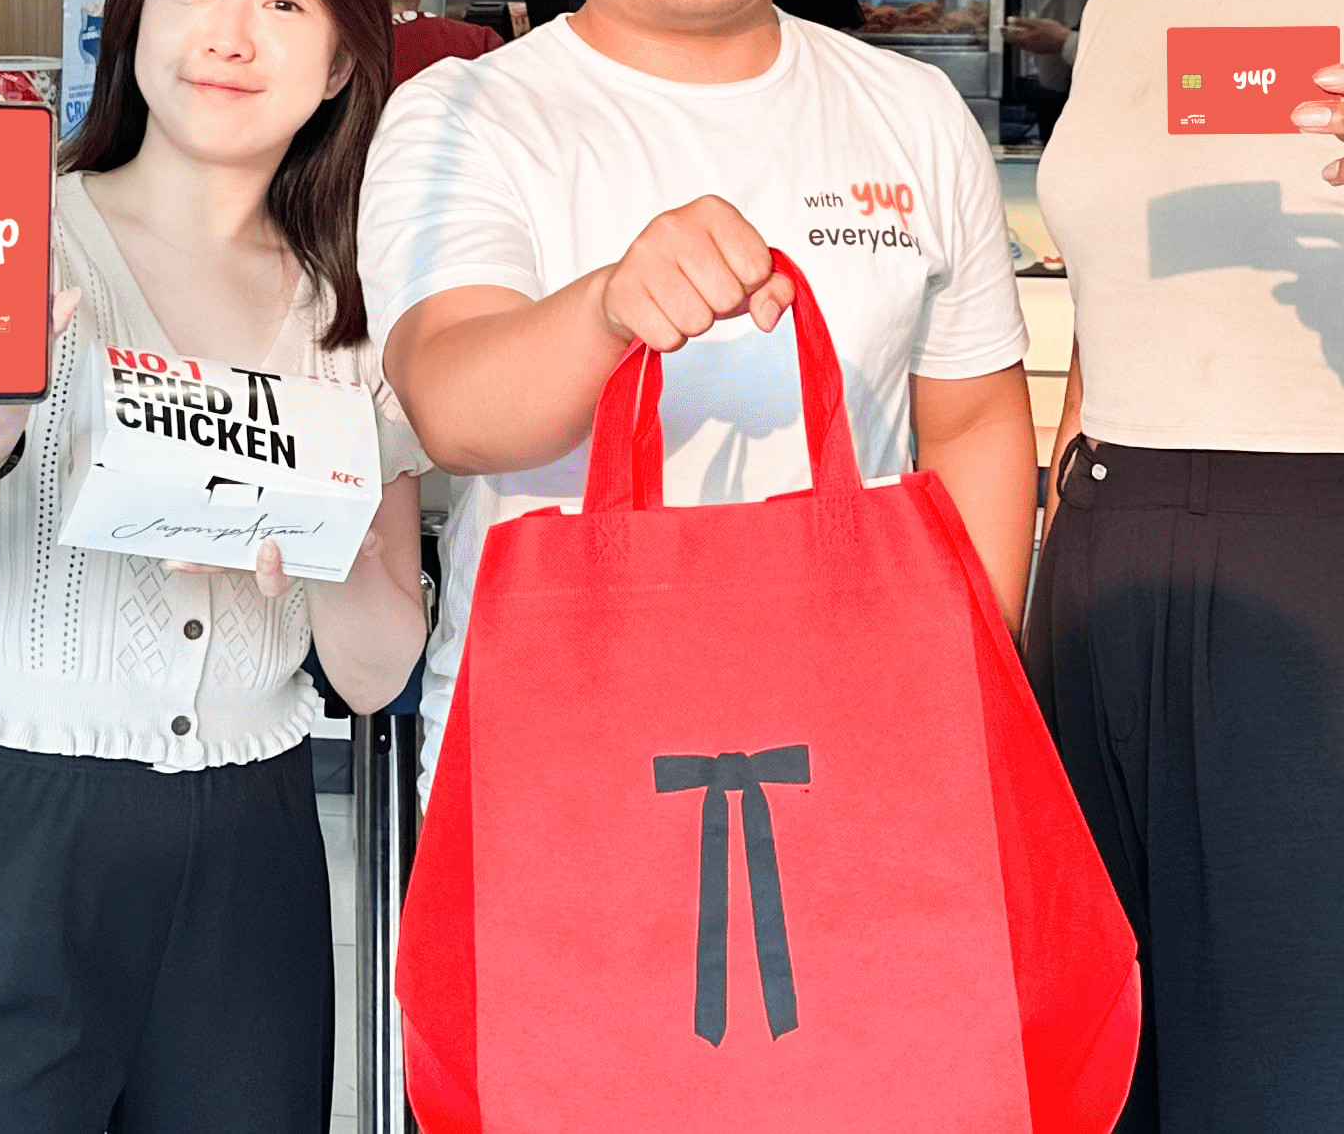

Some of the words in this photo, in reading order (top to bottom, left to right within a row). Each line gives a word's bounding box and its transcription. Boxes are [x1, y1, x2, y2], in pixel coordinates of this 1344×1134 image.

[1233, 68, 1276, 94] yup
[804, 192, 843, 207] with
[851, 182, 913, 230] yup
[809, 226, 921, 256] everyday
[106, 346, 202, 380] NO.1
[112, 367, 233, 415] FRIED
[115, 397, 296, 470] CHICKEN
[331, 470, 365, 488] KFC
